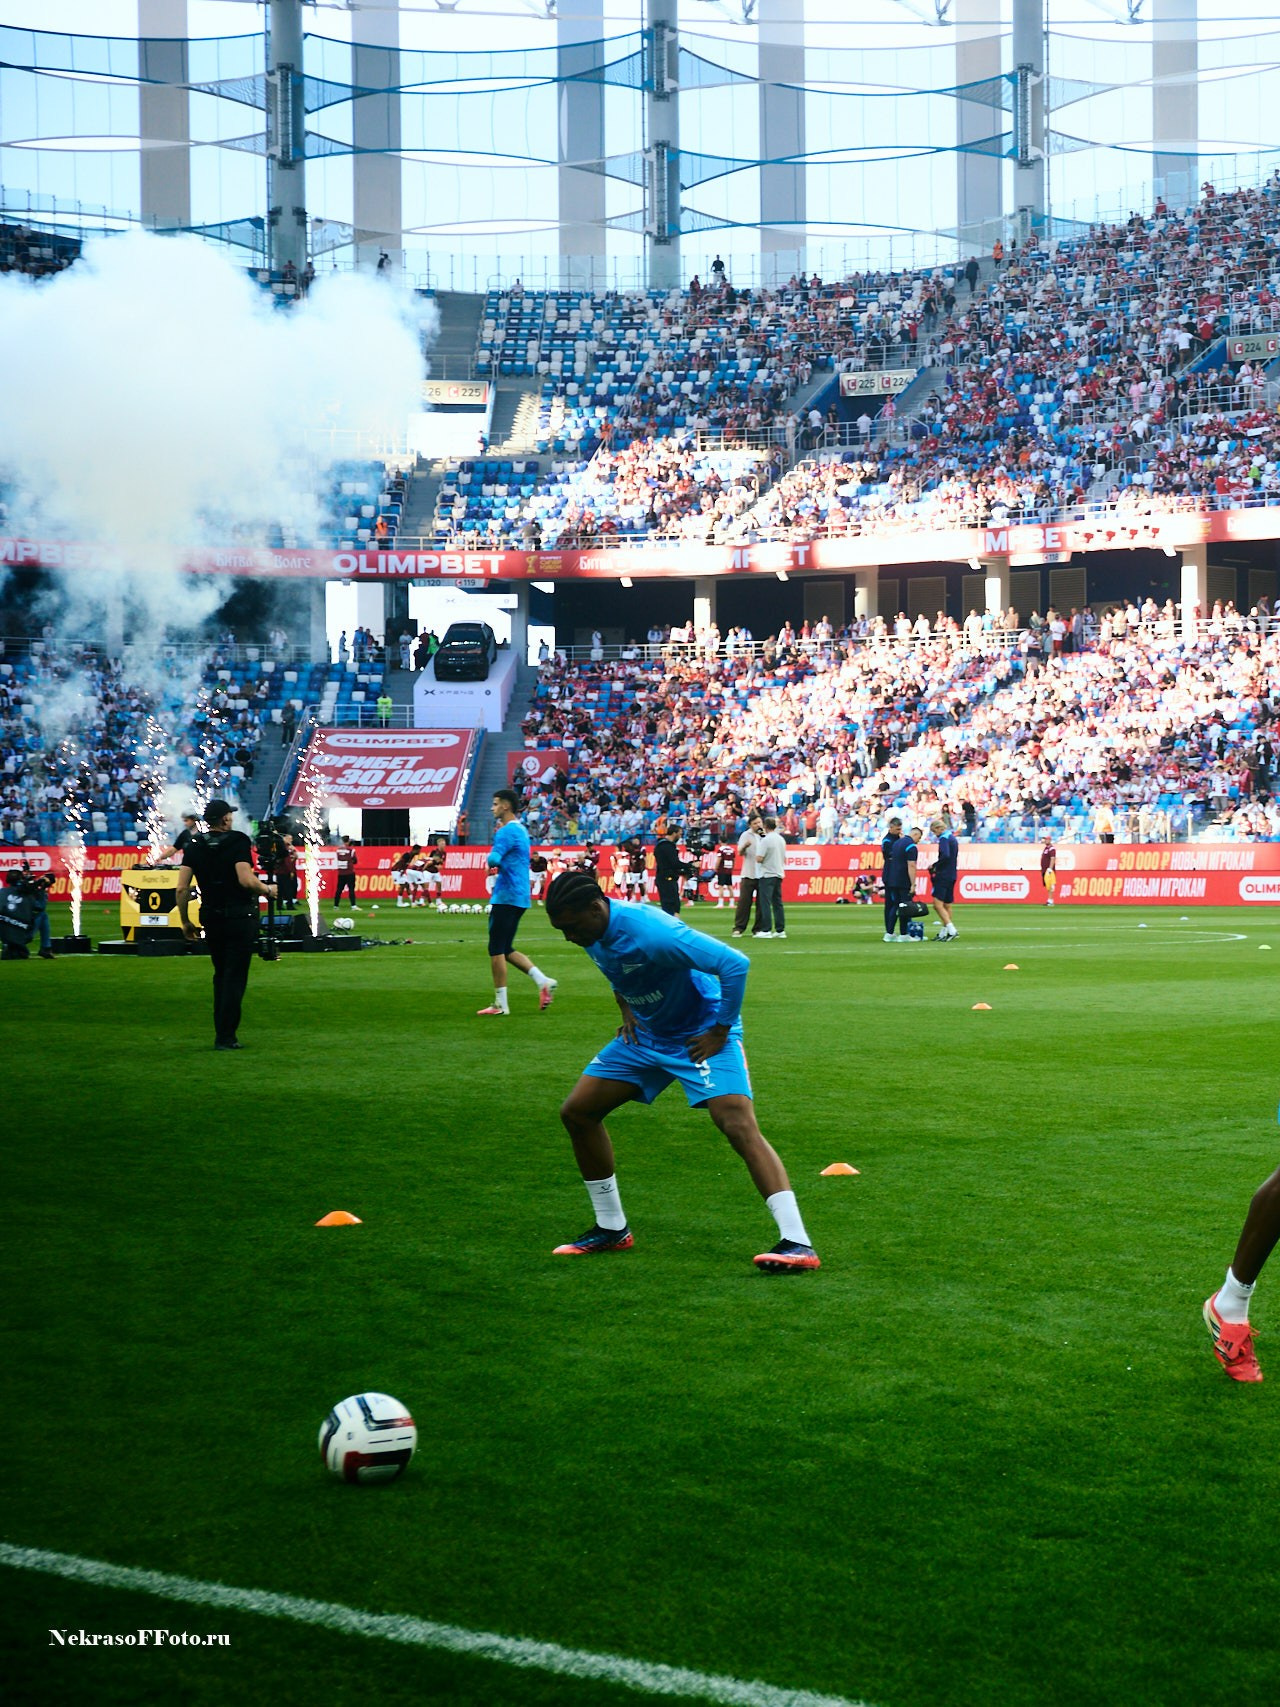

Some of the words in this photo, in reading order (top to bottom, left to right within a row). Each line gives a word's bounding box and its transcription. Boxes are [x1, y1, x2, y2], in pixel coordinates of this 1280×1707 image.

[1245, 343, 1262, 353] 224
[859, 378, 876, 389] 225
[461, 388, 481, 397] 225
[332, 553, 506, 574] OLIMPBET
[427, 579, 441, 587] 120
[463, 579, 476, 587] 119
[336, 737, 450, 745] OLIMPBET
[310, 754, 424, 770] ФРИБЕТ
[336, 769, 386, 785] 30
[386, 767, 459, 786] 000
[373, 784, 446, 795] ИГРОКАМ
[97, 853, 111, 870] 30
[1119, 852, 1134, 870] 30
[1135, 852, 1159, 870] 000
[369, 875, 394, 892] 000
[808, 876, 823, 895] 30
[823, 876, 845, 895] 000
[965, 882, 1024, 892] OLIMPBET
[1072, 877, 1088, 897] 30
[1089, 877, 1113, 897] 000
[1123, 878, 1160, 897] НОВЫМ
[1160, 878, 1207, 898] ИГРОКАМ
